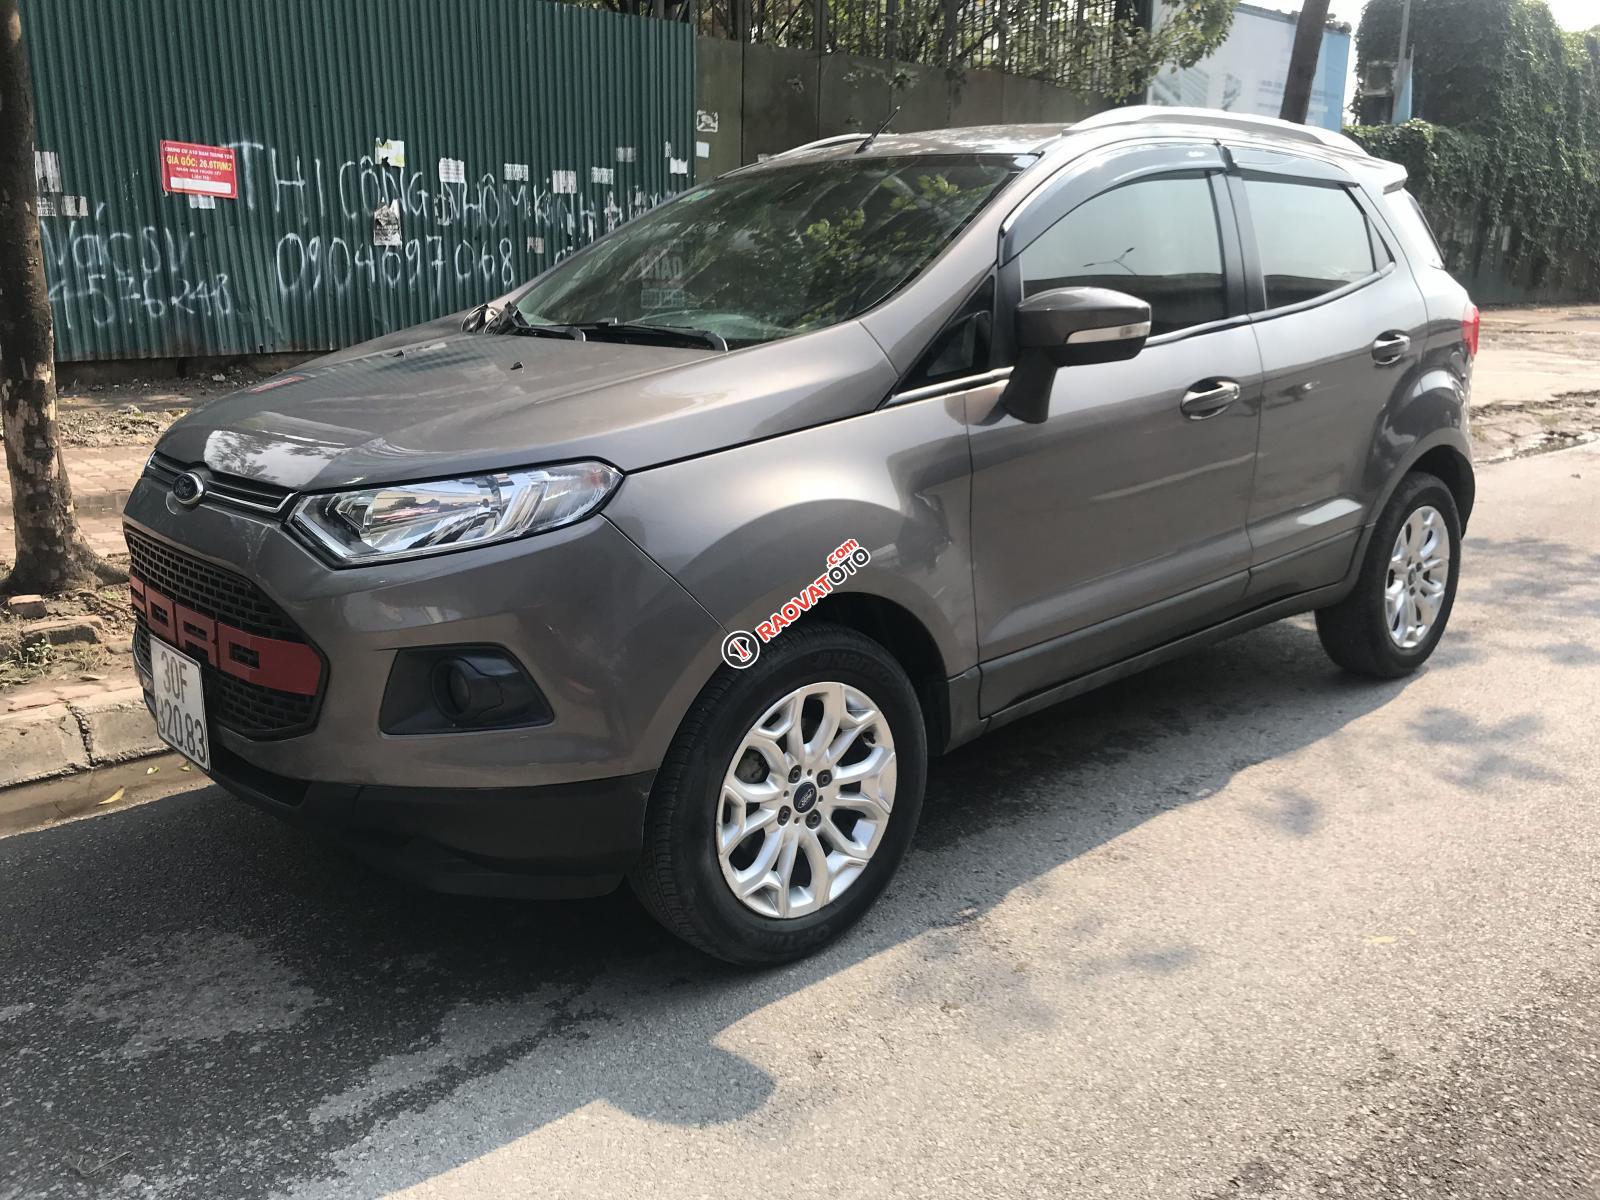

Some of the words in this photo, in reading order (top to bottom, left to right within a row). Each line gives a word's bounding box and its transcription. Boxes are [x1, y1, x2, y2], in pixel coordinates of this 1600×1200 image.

[166, 153, 179, 165] GIÁ
[180, 154, 198, 167] GỐC:
[218, 141, 325, 222] THI
[340, 155, 429, 220] CÔNG
[161, 651, 187, 704] 30F
